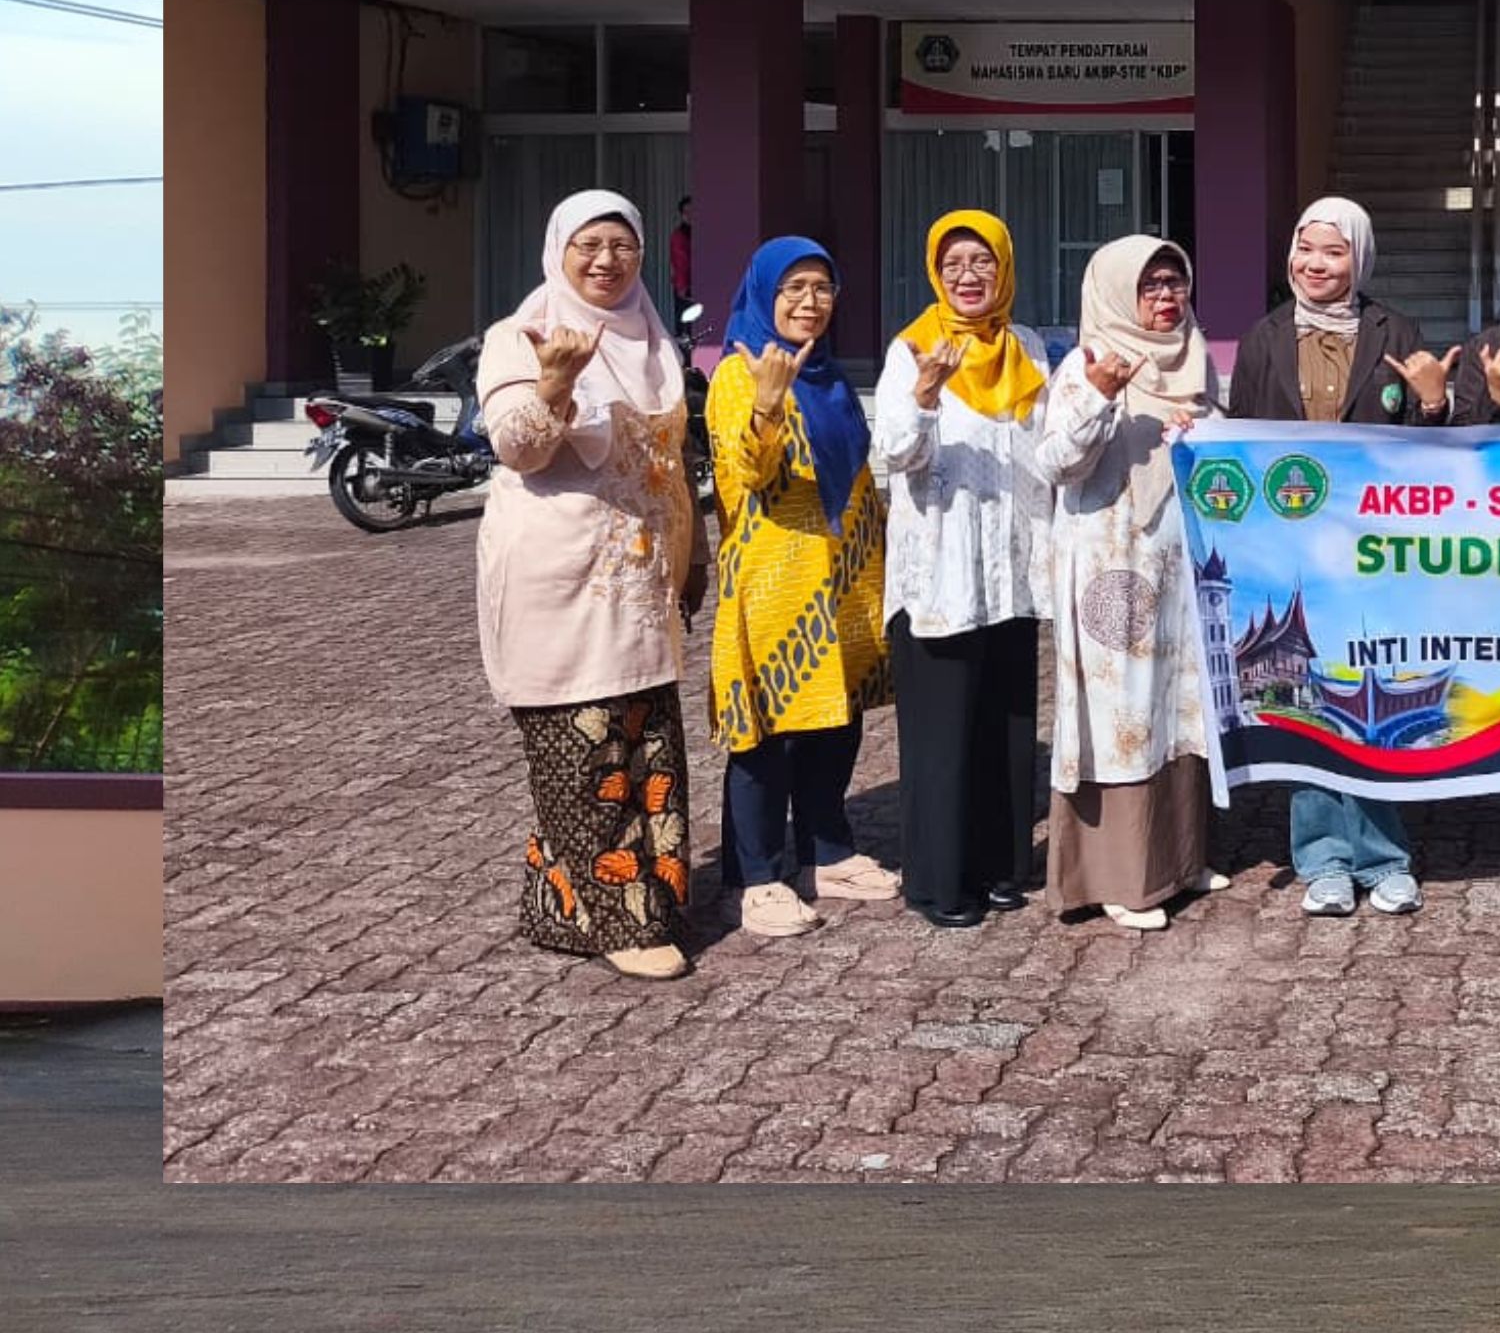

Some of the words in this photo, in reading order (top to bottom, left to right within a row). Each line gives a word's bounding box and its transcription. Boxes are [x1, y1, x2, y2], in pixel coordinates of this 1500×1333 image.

[1009, 44, 1057, 58] TEMPAT
[1061, 43, 1149, 58] PENDAFTARAN
[1359, 486, 1454, 515] AKBP
[1348, 637, 1407, 667] INTI
